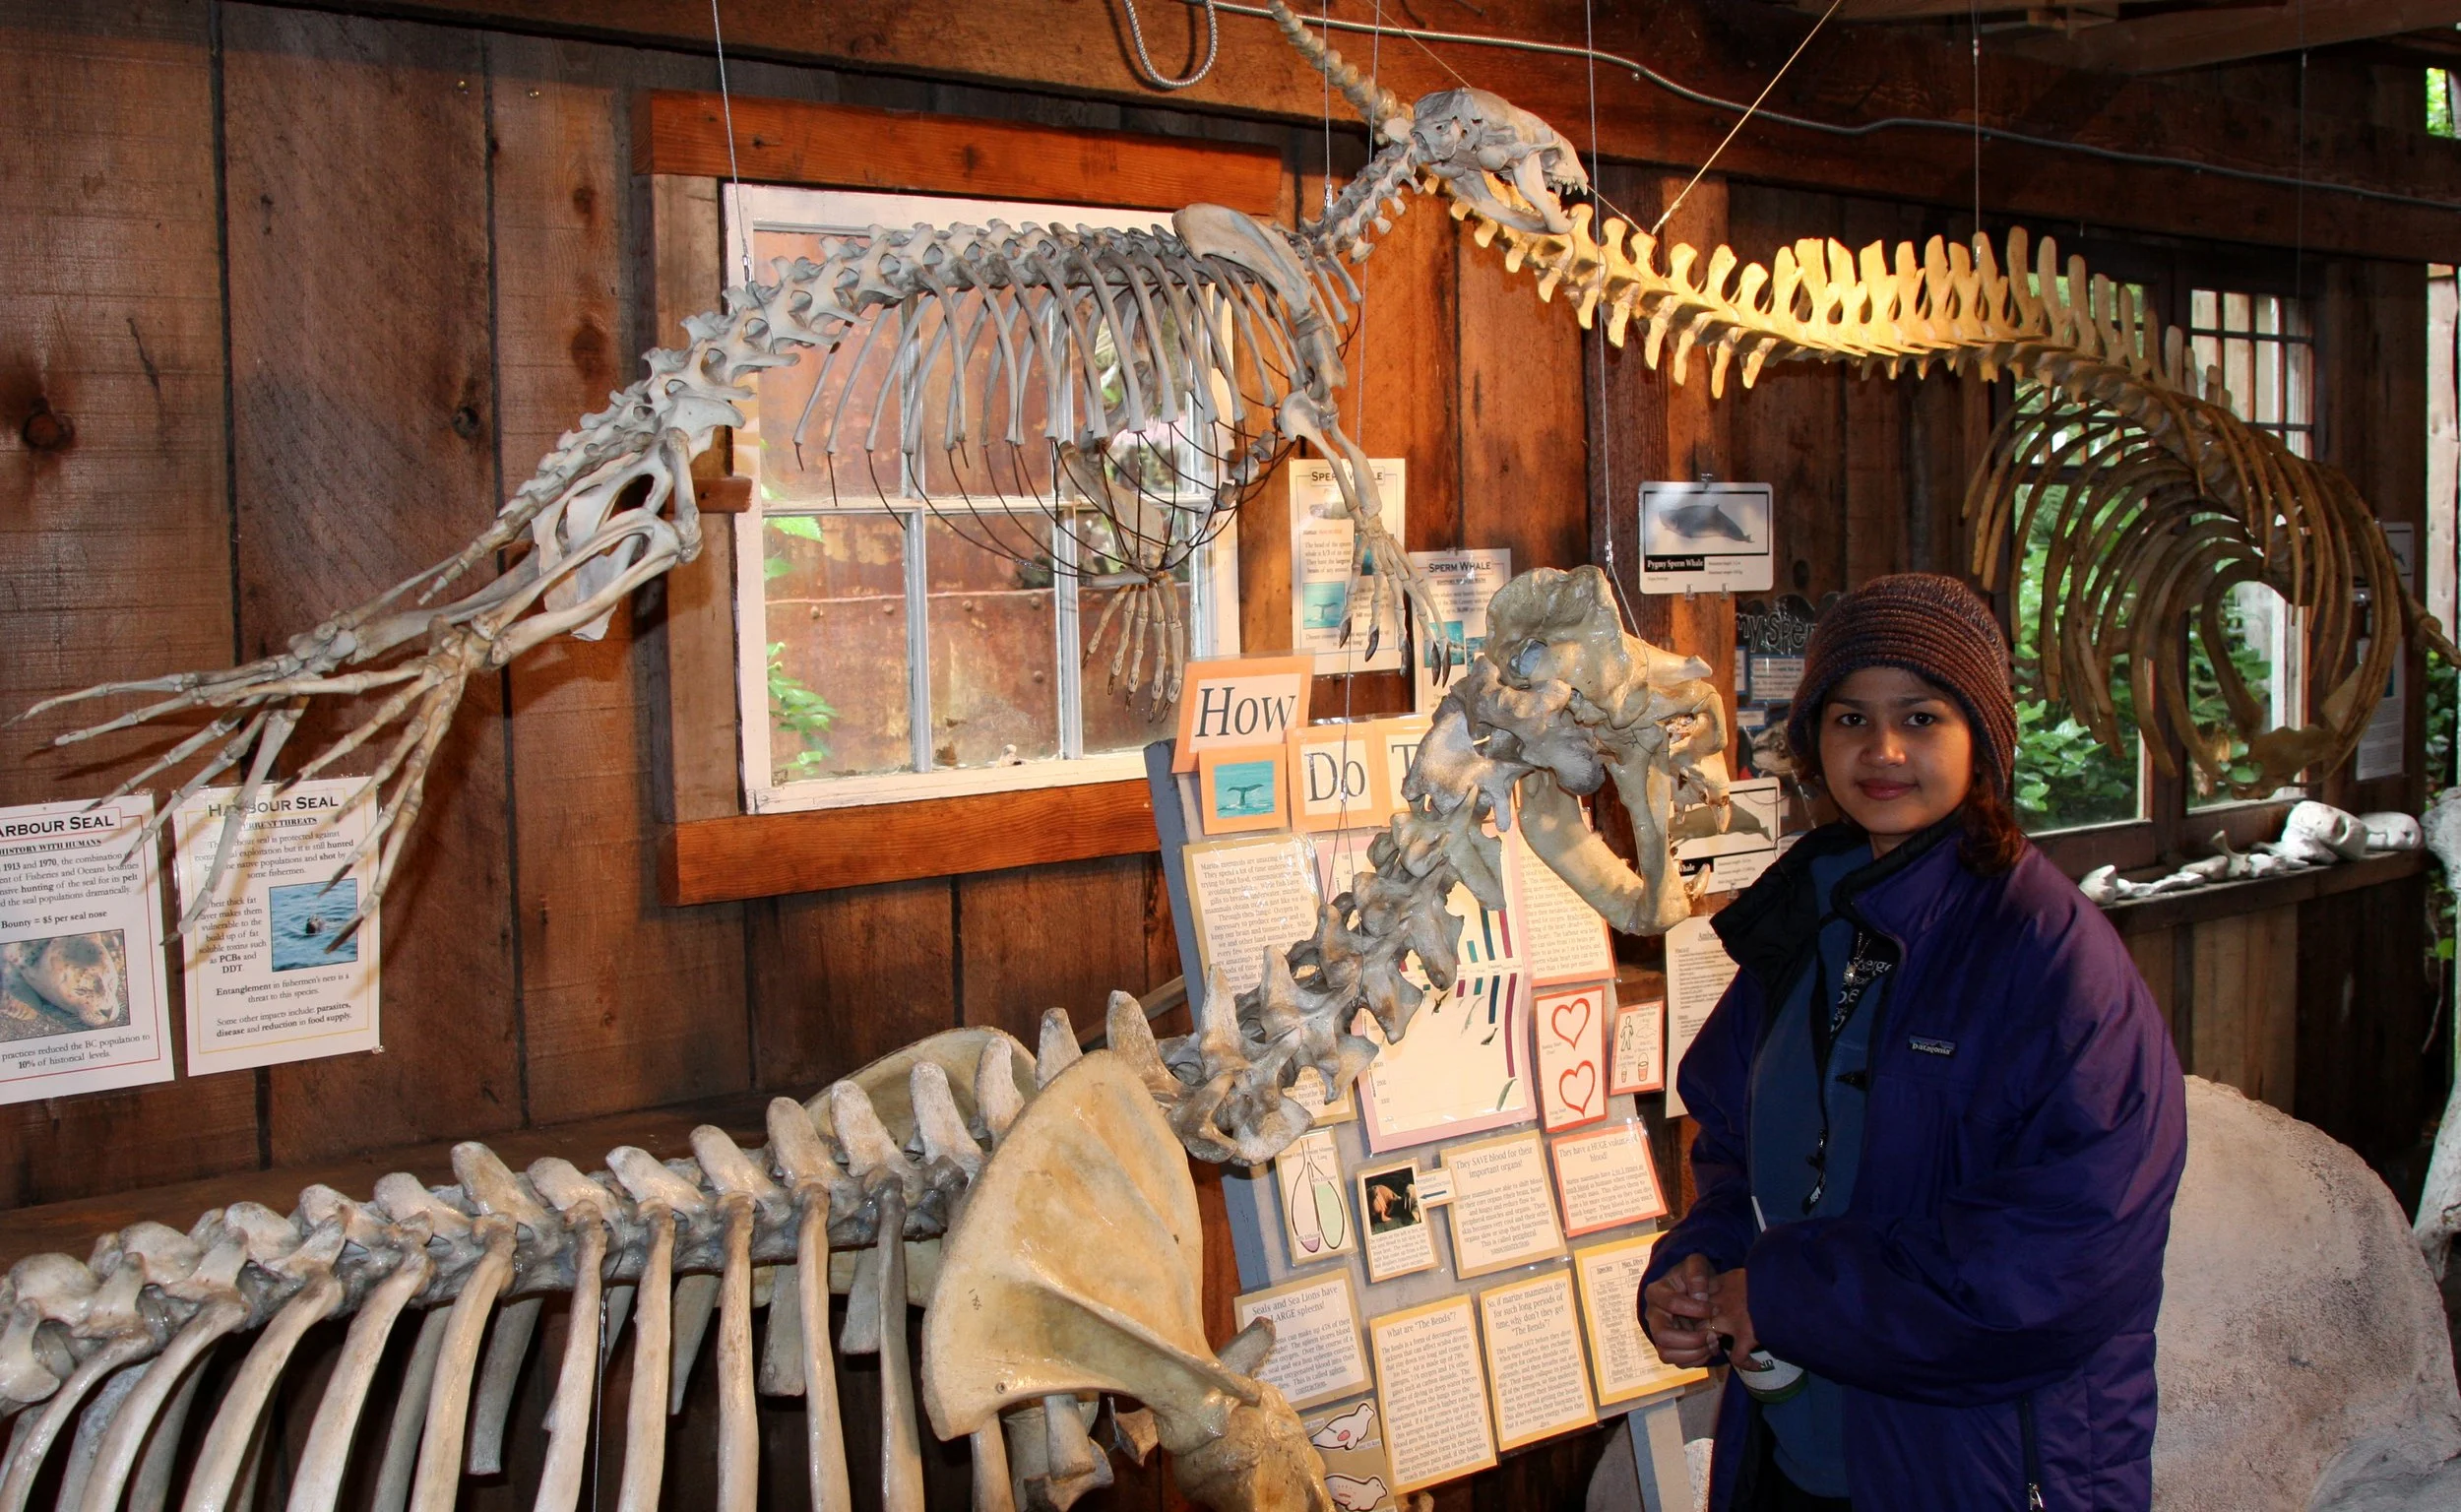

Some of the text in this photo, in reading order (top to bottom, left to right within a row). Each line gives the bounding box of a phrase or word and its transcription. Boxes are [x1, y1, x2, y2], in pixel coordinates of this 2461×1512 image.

[1429, 560, 1491, 573] SPERM WHALE
[1195, 686, 1295, 737] How
[1304, 751, 1365, 801] Do
[296, 795, 339, 809] SEAL
[69, 816, 114, 830] SEAL
[280, 817, 317, 827] THREATS
[38, 842, 63, 850] WITH
[65, 838, 101, 849] HUMANS
[256, 829, 340, 845] seal is protected against
[239, 846, 282, 858] exploitation
[297, 843, 302, 851] it
[327, 838, 353, 849] hunted
[4, 862, 20, 872] 1913
[22, 860, 36, 869] and
[61, 856, 72, 865] the
[75, 851, 121, 863] combination
[236, 850, 346, 868] native populations and shot by
[13, 872, 22, 881] of
[25, 869, 58, 880] Fisheries
[61, 867, 75, 876] and
[77, 866, 104, 875] Oceans
[21, 882, 53, 893] hunting
[55, 880, 64, 889] of
[67, 879, 79, 888] the
[82, 876, 95, 886] seal
[122, 872, 138, 884] pelt
[8, 897, 19, 906] the
[22, 894, 36, 904] seal
[38, 891, 83, 905] populations
[210, 898, 223, 907] heir
[1, 918, 31, 928] Bounty
[42, 915, 52, 925] $5
[54, 916, 67, 925] per
[70, 912, 86, 921] seal
[220, 953, 240, 963] PCBs
[243, 951, 257, 960] and
[216, 981, 271, 995] Entanglement
[273, 979, 280, 988] in
[282, 976, 320, 987] fishermen's
[322, 974, 336, 982] nets
[248, 993, 268, 1003] threat
[279, 990, 291, 999] this
[217, 1017, 236, 1026] Some
[238, 1013, 258, 1023] other
[260, 1010, 286, 1022] impacts
[217, 1028, 244, 1037] disease
[246, 1023, 259, 1033] and
[261, 1019, 297, 1031] reduction
[307, 1015, 324, 1025] food
[2, 1049, 35, 1062] practices
[37, 1042, 68, 1054] reduced
[70, 1041, 82, 1050] the
[85, 1040, 95, 1048] BC
[98, 1035, 140, 1048] population
[1912, 1043, 1952, 1055] patagonia
[19, 1059, 35, 1069] 10%
[49, 1052, 85, 1065] historical
[1456, 1146, 1533, 1169] They SAVE blood for their
[1469, 1164, 1499, 1179] important
[1252, 1286, 1338, 1315] Seals and Sea Lions have
[1496, 1295, 1500, 1305] if
[1502, 1292, 1522, 1304] marine
[1524, 1285, 1552, 1299] mammals
[1553, 1282, 1566, 1292] dive
[1503, 1303, 1517, 1315] such
[1518, 1302, 1532, 1311] long
[1533, 1295, 1554, 1310] periods
[1555, 1292, 1563, 1302] of
[1271, 1307, 1294, 1323] LARGE
[1510, 1314, 1521, 1325] why
[1540, 1307, 1552, 1317] they
[1554, 1303, 1564, 1316] get
[1387, 1325, 1402, 1339] What
[1404, 1325, 1413, 1334] are
